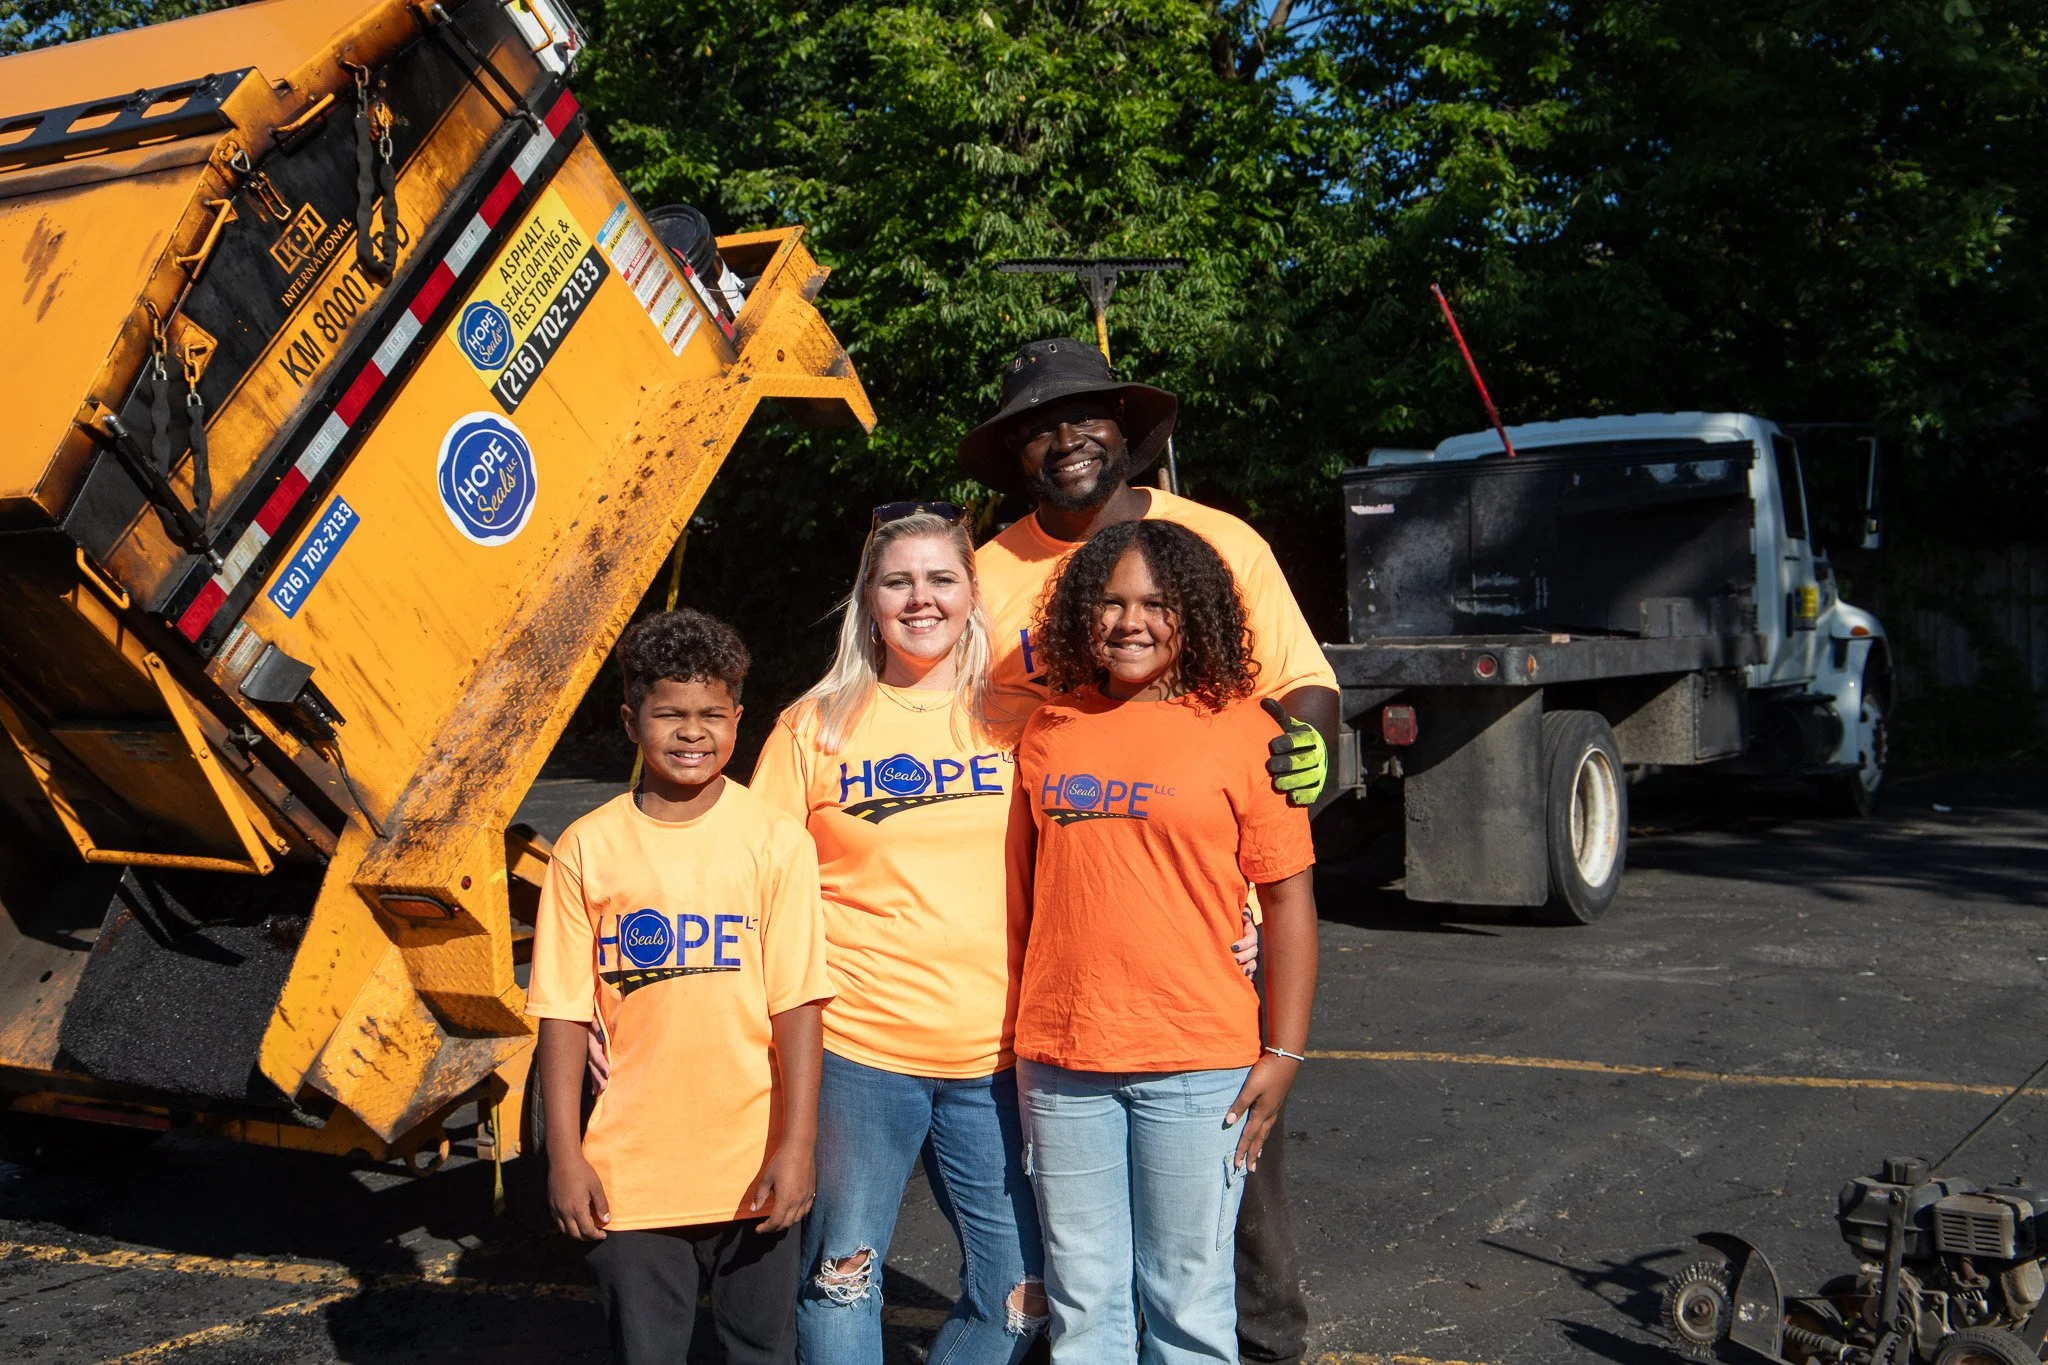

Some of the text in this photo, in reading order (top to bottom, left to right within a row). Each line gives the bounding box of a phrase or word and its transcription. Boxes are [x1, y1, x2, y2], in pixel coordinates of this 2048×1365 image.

[603, 210, 620, 233] NOTICE
[613, 219, 630, 245] CAUTION
[281, 218, 353, 308] INTERNATIONAL
[499, 216, 547, 284] ASPHALT
[501, 219, 570, 313] SEALCOATING &
[632, 243, 649, 267] DANGER
[512, 232, 582, 330] RESTORATION
[468, 311, 497, 350] HOPE
[497, 257, 600, 405] (216) 702-2133
[665, 296, 683, 321] CAUTION
[278, 329, 326, 388] KM
[479, 329, 502, 362] Seals
[458, 437, 508, 505] HOPE
[477, 467, 516, 523] Seals
[274, 566, 310, 612] (216)
[301, 502, 353, 570] 702-2133
[839, 753, 1004, 803] HOPE
[883, 767, 924, 783] Seals
[1041, 773, 1176, 817] HOPE LLC
[1069, 783, 1098, 798] Seals
[597, 909, 744, 967] HOPE
[628, 927, 667, 947] Seals
